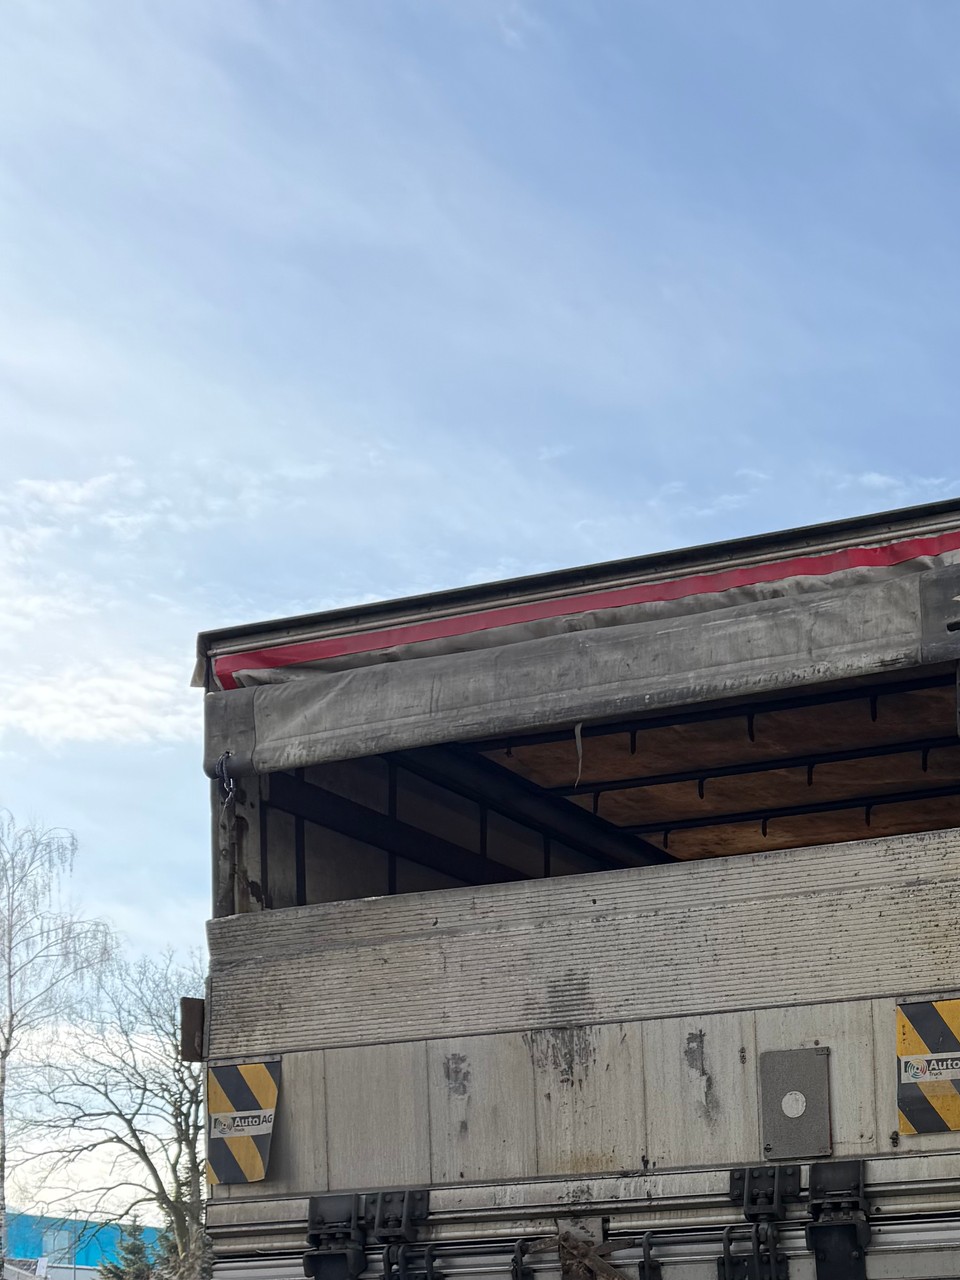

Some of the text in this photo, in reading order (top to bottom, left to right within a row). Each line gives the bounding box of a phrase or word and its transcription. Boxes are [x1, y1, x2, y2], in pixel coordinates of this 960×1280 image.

[929, 1058, 960, 1070] Auto
[234, 1113, 273, 1127] Auto AG
